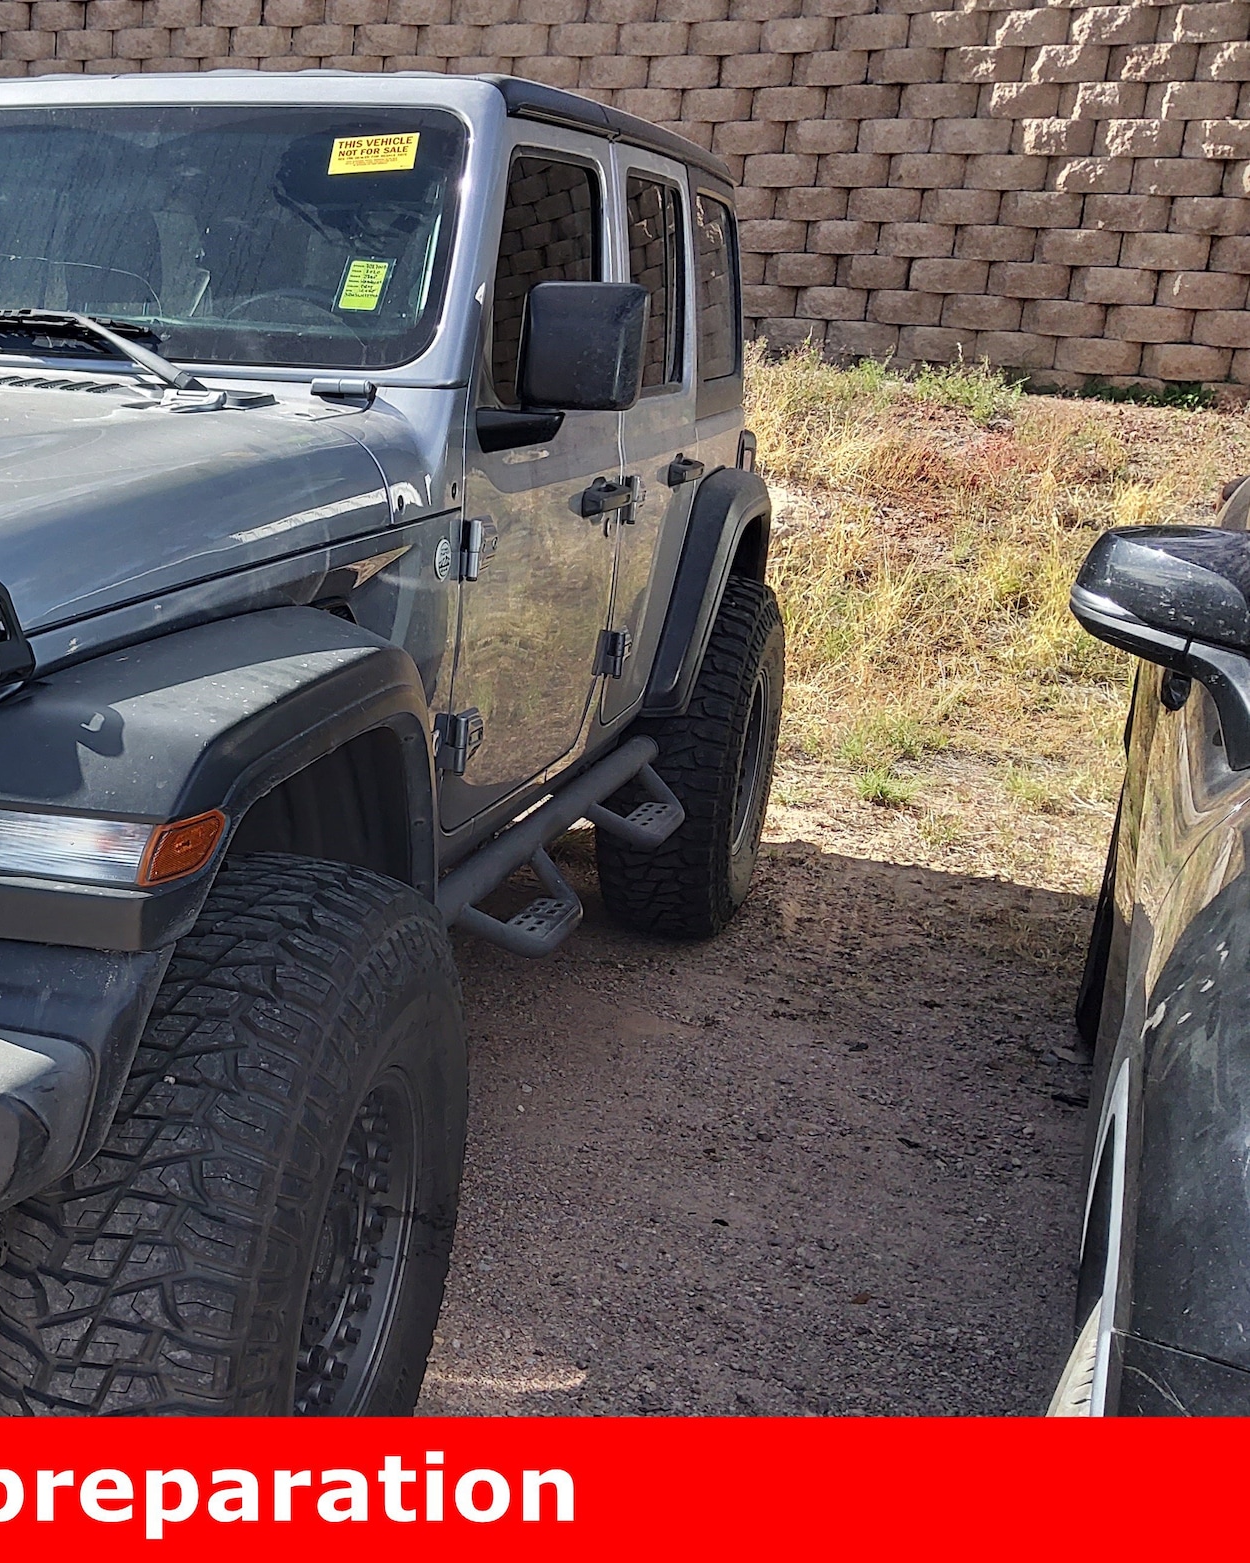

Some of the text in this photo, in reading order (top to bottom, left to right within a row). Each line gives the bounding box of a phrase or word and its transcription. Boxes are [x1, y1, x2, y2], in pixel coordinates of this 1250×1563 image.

[338, 136, 413, 149] THIS VEHICLE
[338, 149, 358, 157] NOT
[360, 148, 380, 156] FOR
[383, 146, 409, 154] SALE
